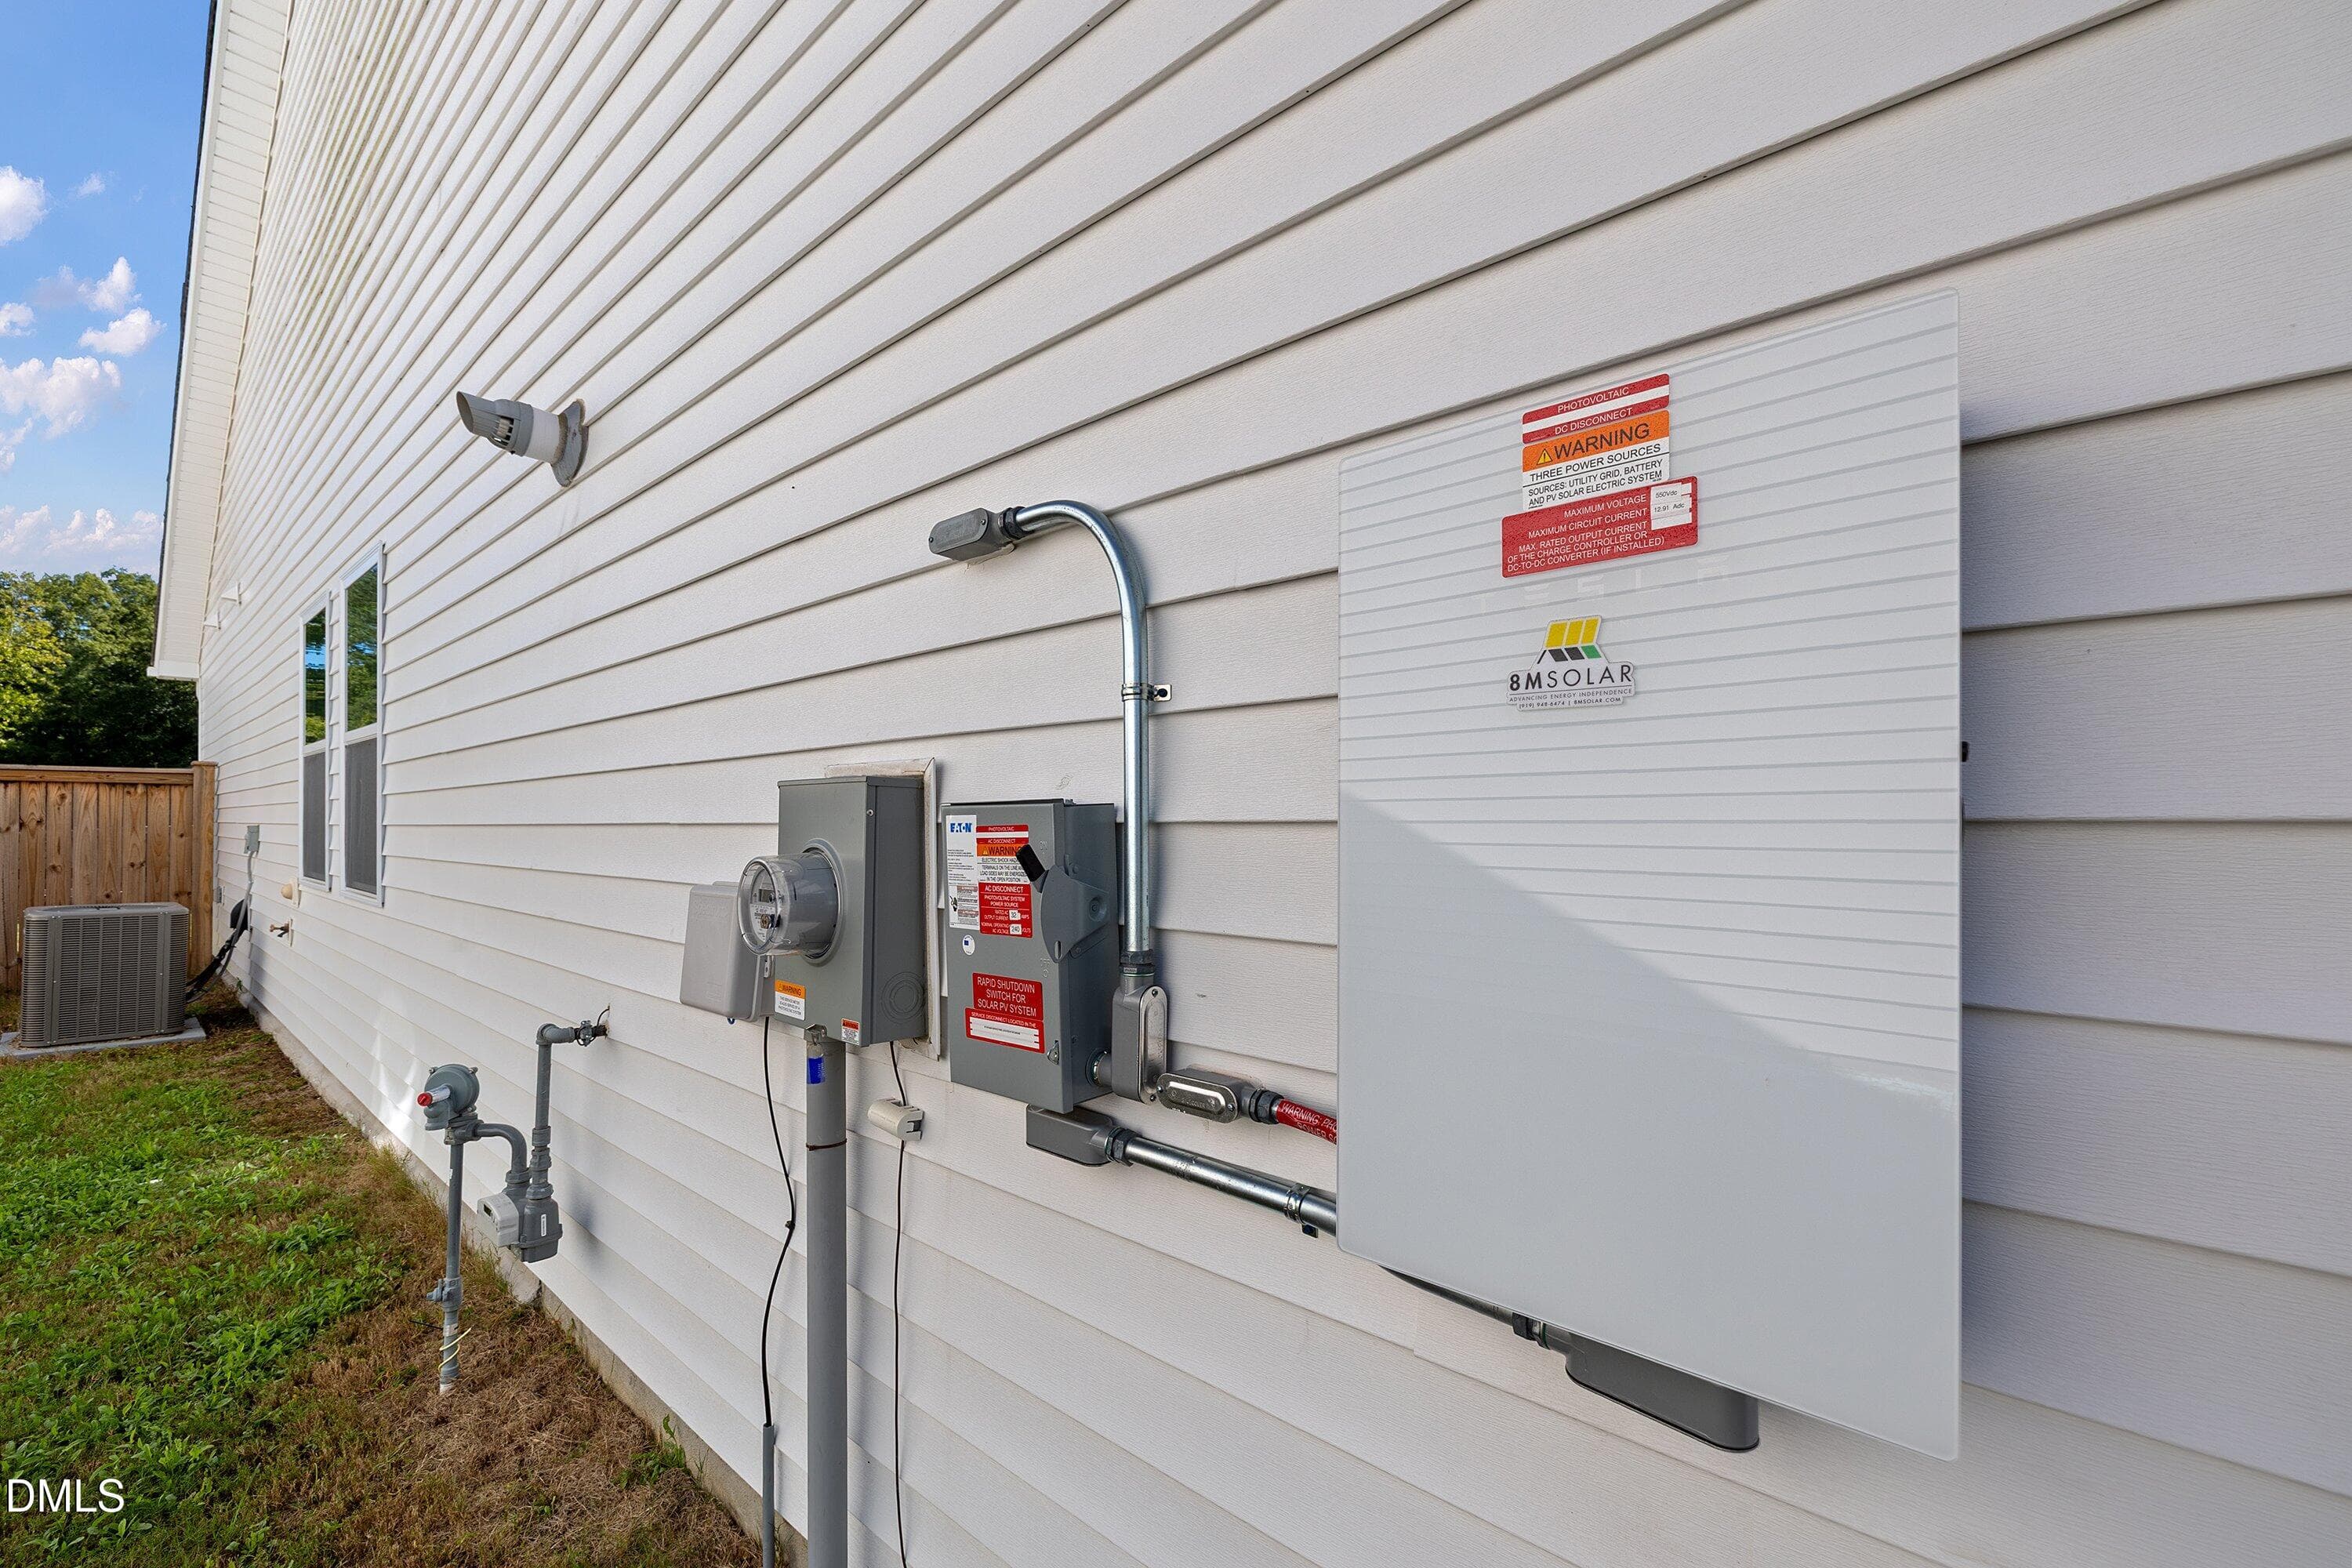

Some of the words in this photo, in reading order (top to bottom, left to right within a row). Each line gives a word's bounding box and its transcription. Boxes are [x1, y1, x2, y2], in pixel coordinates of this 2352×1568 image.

[1558, 387, 1629, 413] PHOTOVOLTAIC
[1555, 425, 1569, 434] DC
[1570, 408, 1633, 430] DISCONNECT
[1554, 423, 1650, 459] WARNING
[1530, 467, 1563, 481] THREE
[1566, 457, 1604, 474] POWER
[1607, 444, 1661, 463] SOURCES
[1529, 482, 1566, 496] SOURCES:
[1569, 473, 1598, 487] UTILITY
[1600, 469, 1621, 481] GRID,
[1624, 459, 1663, 474] BATTERY
[1529, 497, 1544, 506] AND
[1546, 494, 1556, 503] PV
[1558, 489, 1584, 500] SOLAR
[1586, 480, 1626, 494] ELECTRIC
[1628, 470, 1662, 485] SYSTEM
[1564, 504, 1605, 517] MAXIMUM
[1607, 494, 1646, 510] VOLTAGE
[1656, 489, 1678, 498] 550Vdc
[1519, 543, 1536, 552] MAX.
[1540, 536, 1566, 548] RATED
[1568, 528, 1602, 544] OUTPUT
[1605, 521, 1647, 536] CURRENT
[1529, 525, 1566, 539] MAXIMUM
[1569, 517, 1602, 531] CIRCUIT
[1605, 508, 1647, 524] CURRENT
[1508, 555, 1518, 564] OF
[1520, 552, 1535, 561] THE
[1537, 546, 1570, 557] CHARGE
[1573, 534, 1632, 552] CONTROLLER
[1634, 531, 1647, 539] OR
[1508, 558, 1545, 572] DC-TO-DC
[1548, 550, 1599, 565] CONVERTER
[1601, 547, 1612, 557] (IF
[1613, 535, 1664, 554] INSTALLED)
[1510, 665, 1632, 691] 8MSOLAR
[949, 822, 972, 833] EATON
[978, 977, 996, 988] RAPID
[997, 980, 1035, 993] SHUTDOWN
[986, 989, 1011, 1001] SWITCH
[1012, 993, 1025, 1004] FOR
[978, 998, 999, 1010] SOLAR
[1000, 1003, 1008, 1011] PV
[1010, 1004, 1036, 1017] SYSTEM
[986, 1014, 1007, 1022] DISCONNECT
